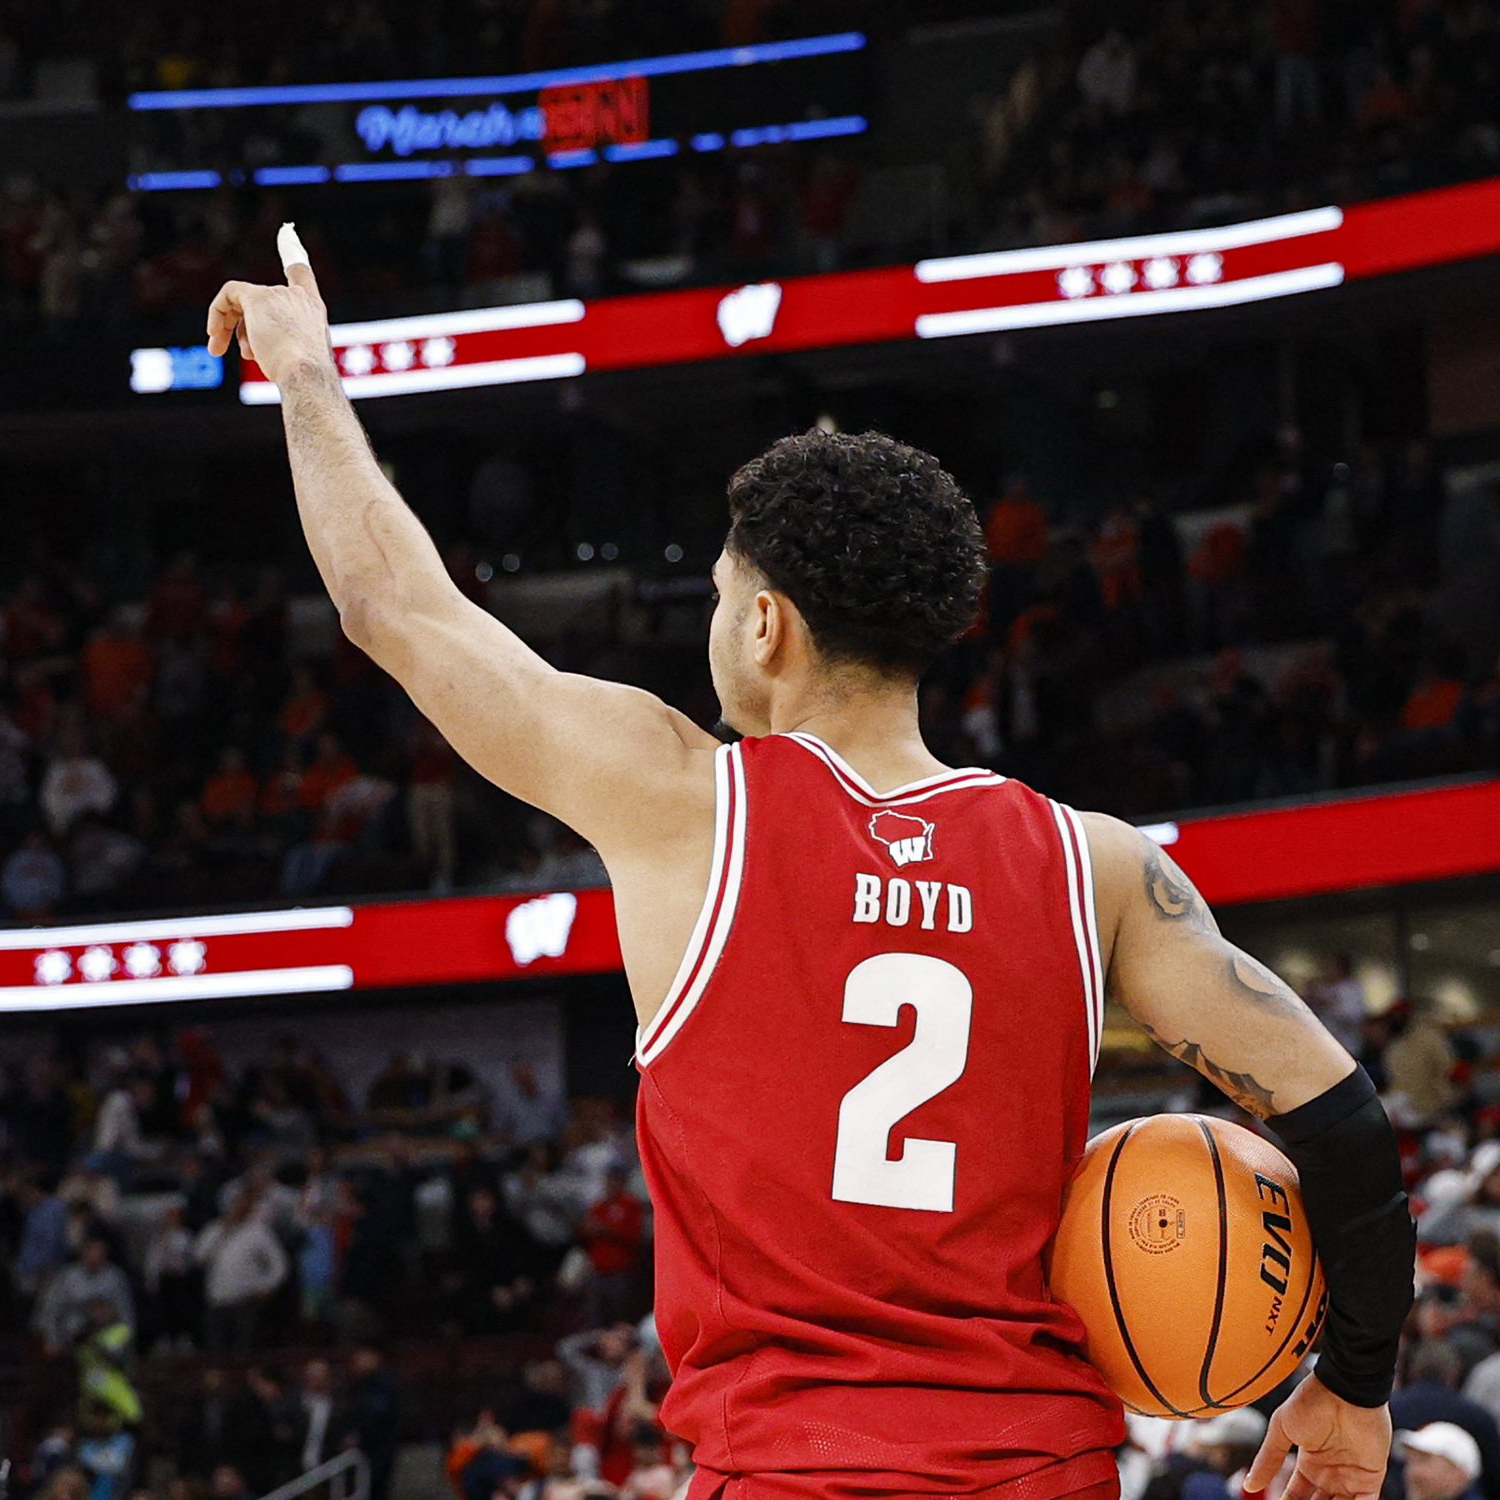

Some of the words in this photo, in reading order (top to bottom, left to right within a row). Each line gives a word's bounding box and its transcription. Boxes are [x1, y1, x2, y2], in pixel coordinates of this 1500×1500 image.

[888, 836, 926, 867] W
[505, 891, 577, 966] W
[852, 872, 973, 934] BOYD
[831, 952, 974, 1213] 2
[1254, 1172, 1293, 1296] EVO
[1265, 1296, 1283, 1336] NXT
